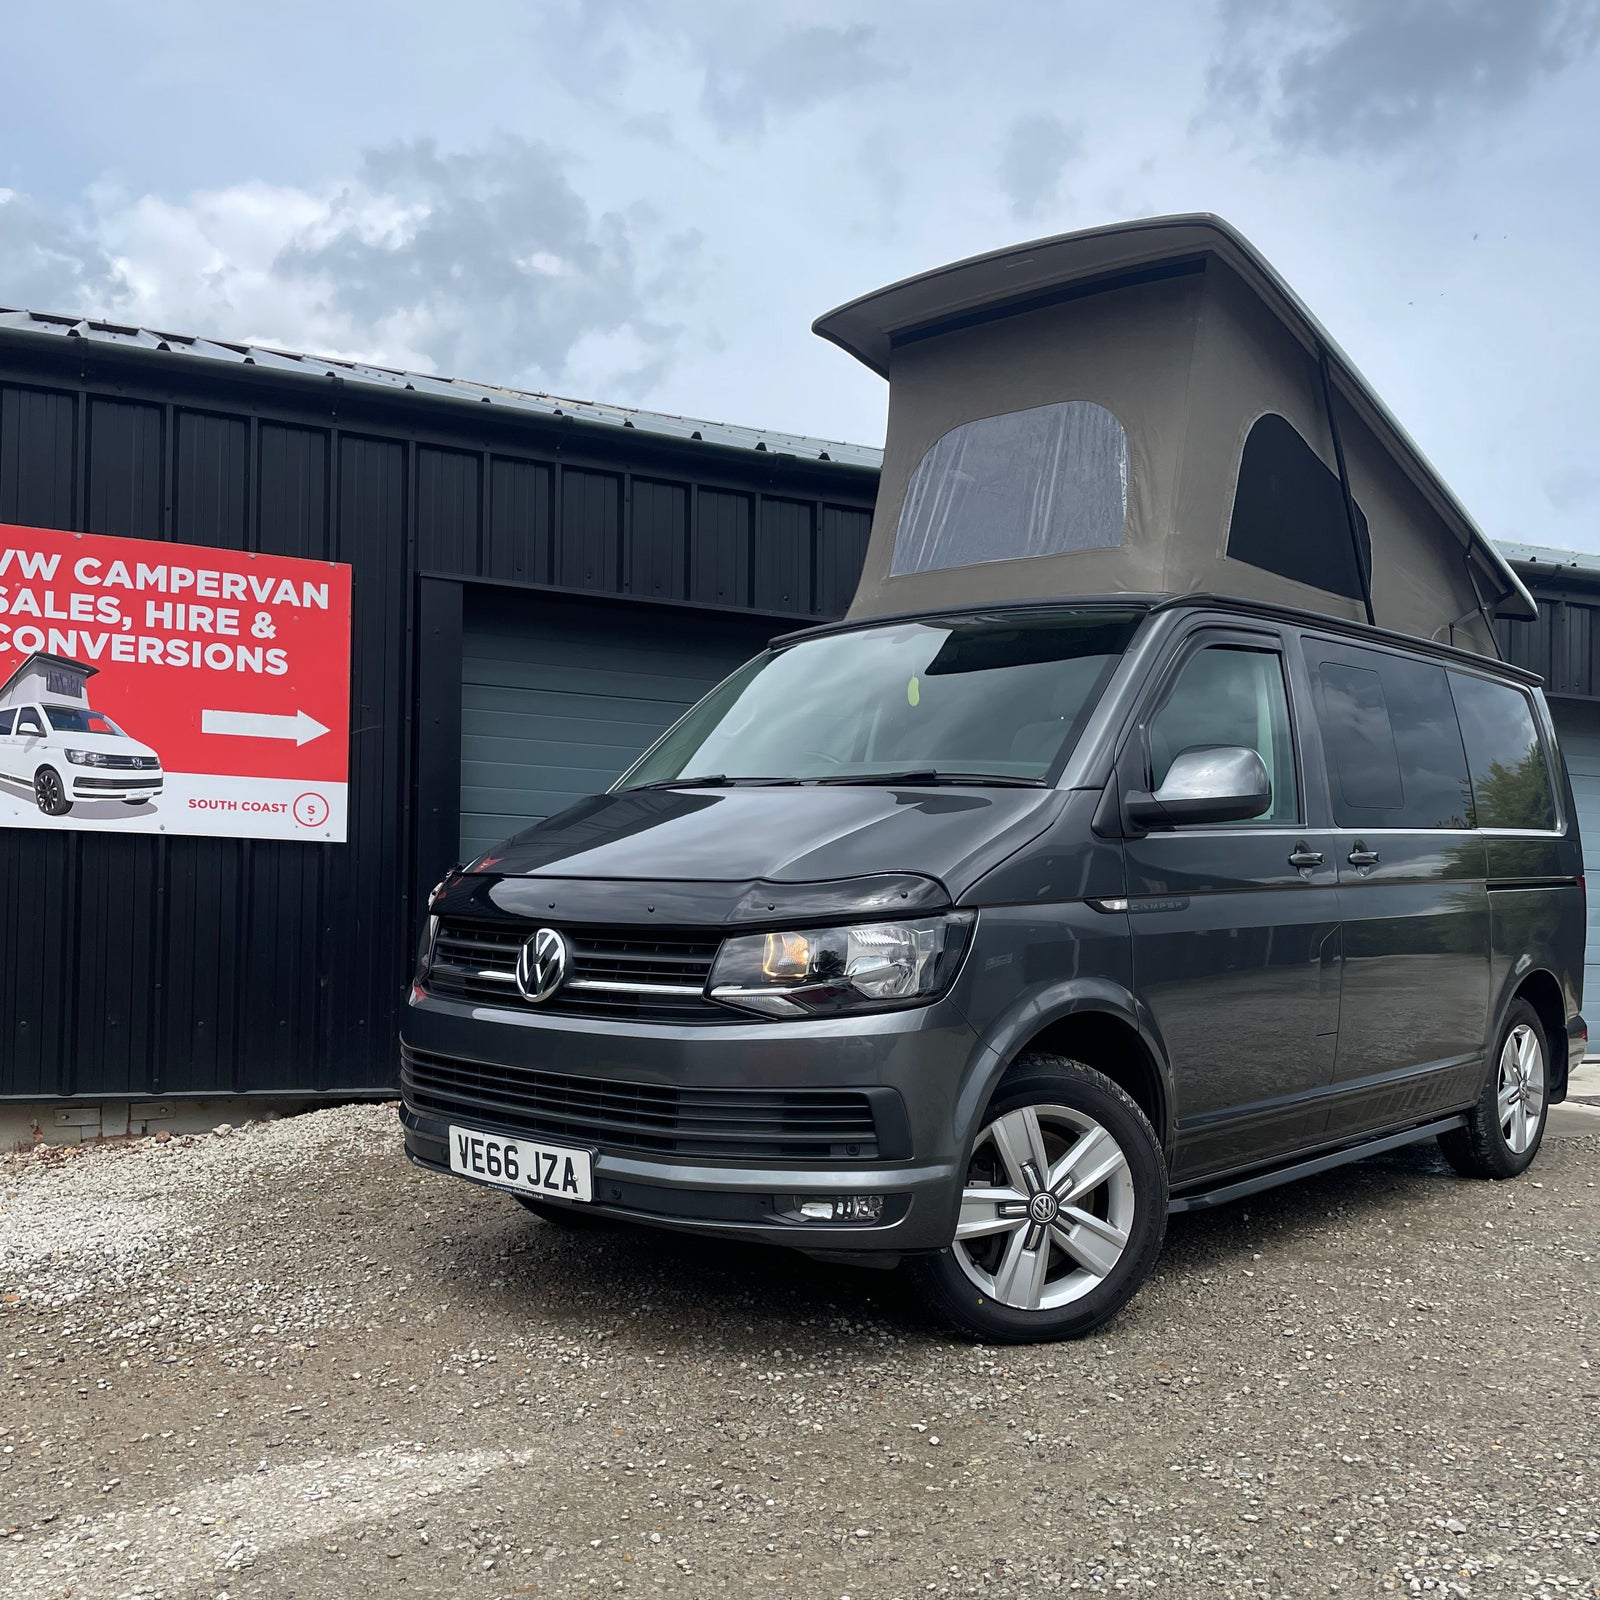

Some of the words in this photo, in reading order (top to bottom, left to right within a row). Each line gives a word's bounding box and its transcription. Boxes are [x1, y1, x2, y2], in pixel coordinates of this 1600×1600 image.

[73, 557, 329, 610] CAMPERVAN
[145, 600, 240, 636] HIRE
[250, 611, 277, 640] &
[188, 799, 237, 810] SOUTH
[241, 802, 287, 813] COAST
[307, 805, 316, 815] S
[457, 1134, 520, 1181] VE66
[526, 1151, 579, 1194] JZA
